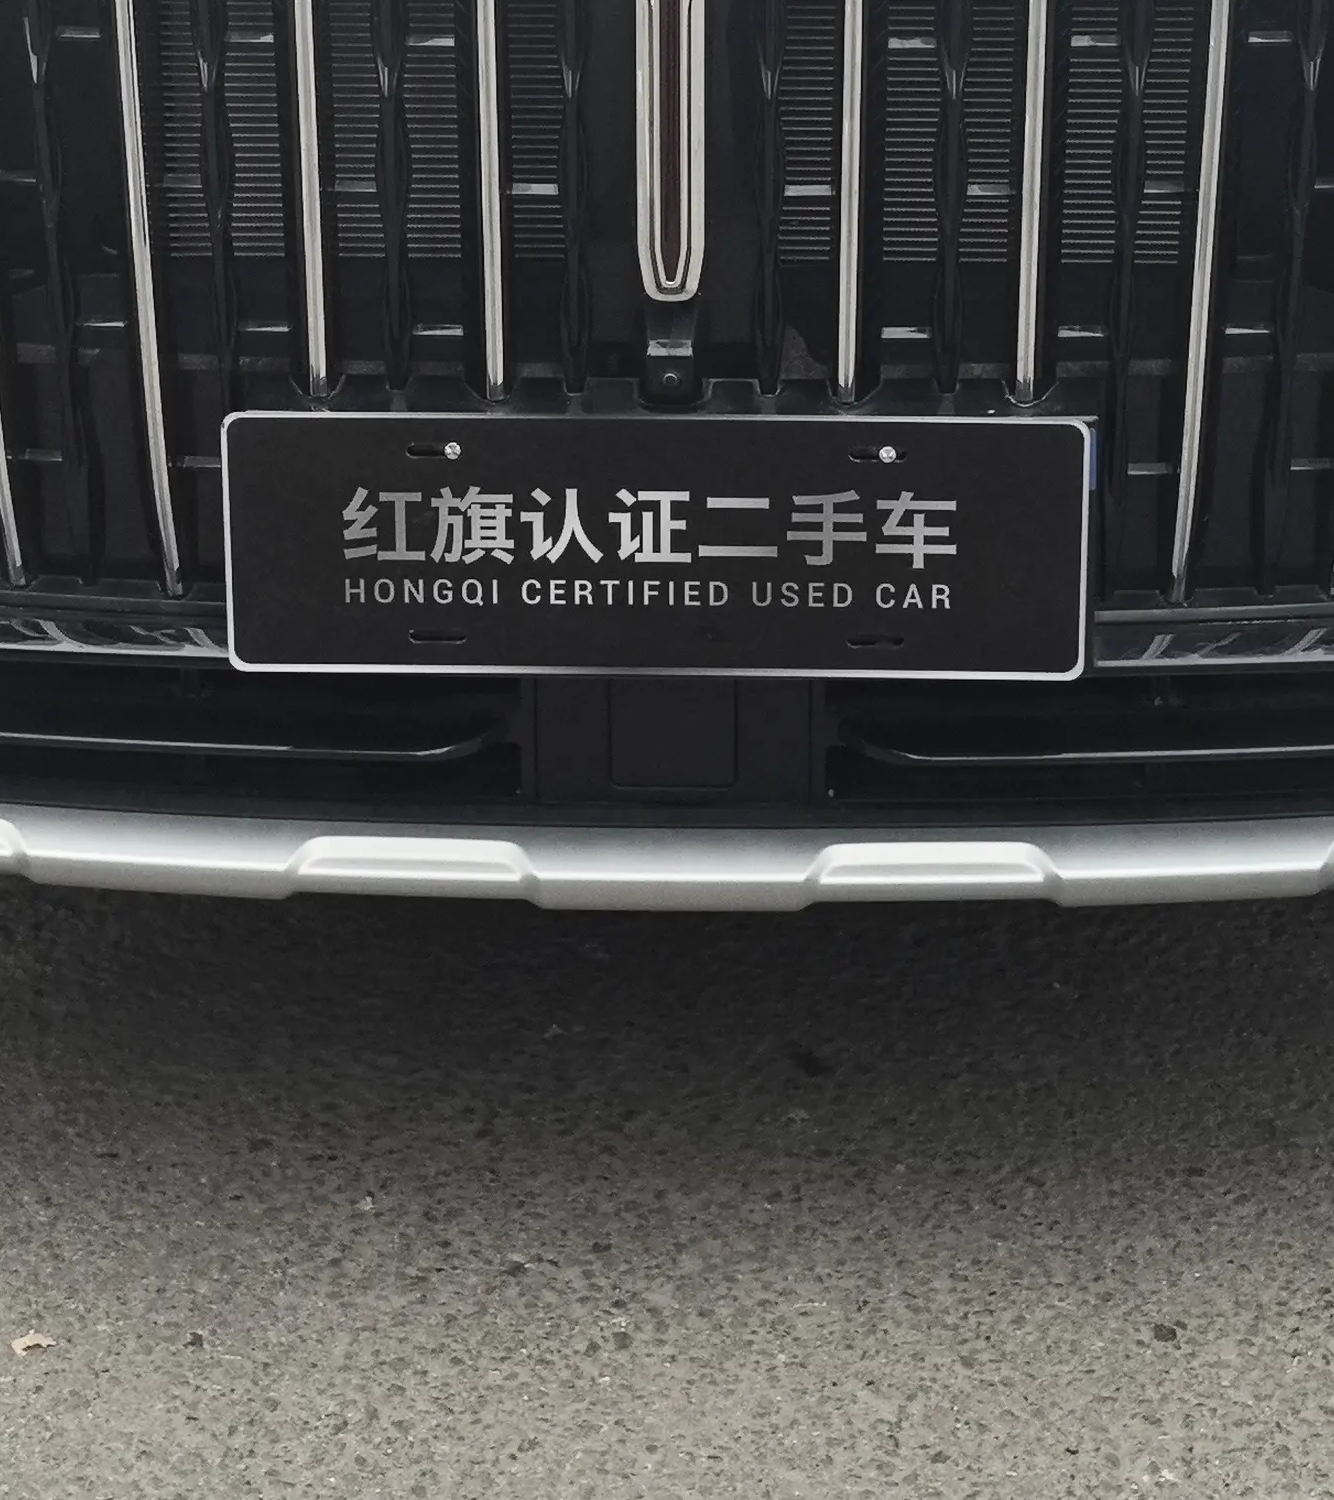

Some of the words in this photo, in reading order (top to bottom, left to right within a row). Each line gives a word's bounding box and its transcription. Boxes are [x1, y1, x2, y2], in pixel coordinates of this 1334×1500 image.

[341, 485, 958, 569] 红旗认证二手车
[344, 578, 499, 607] HONGQI
[521, 579, 729, 607] CERTIFIED
[752, 581, 853, 608] USED
[875, 583, 951, 610] CAR
